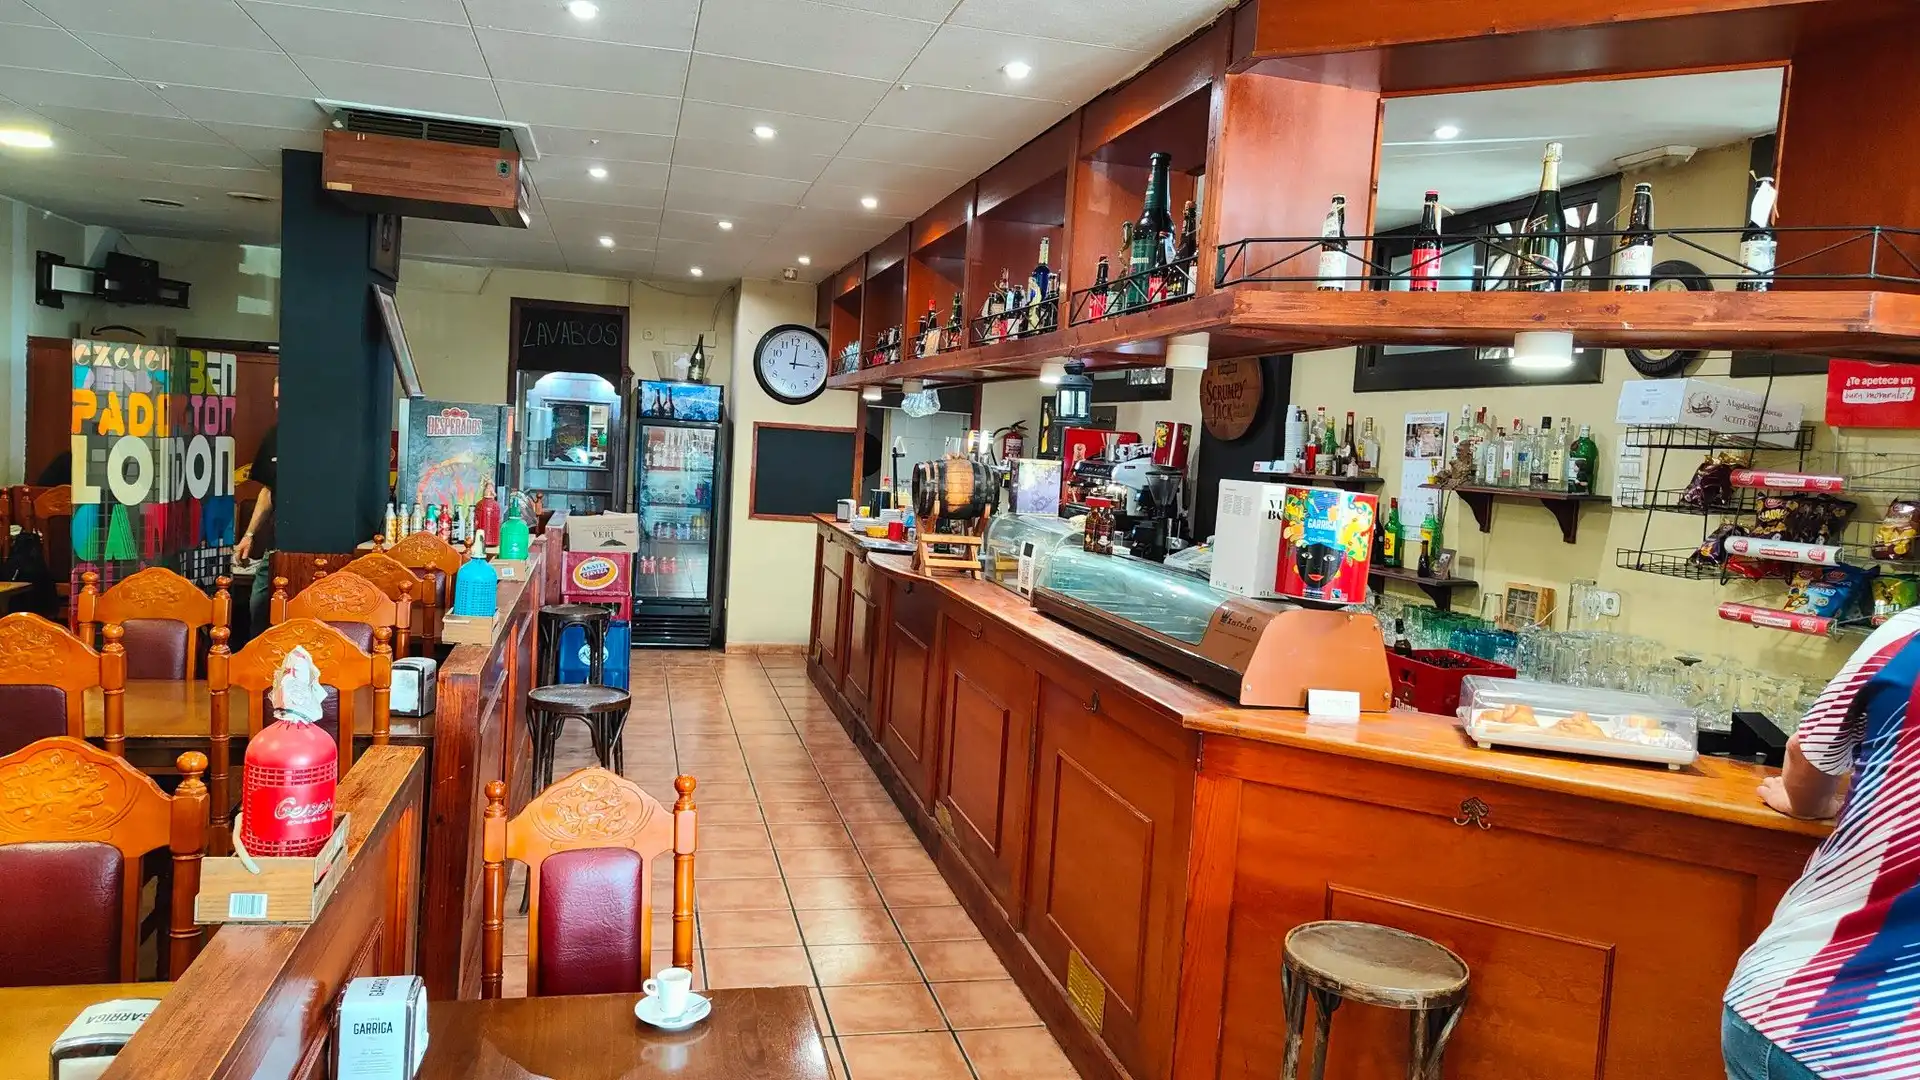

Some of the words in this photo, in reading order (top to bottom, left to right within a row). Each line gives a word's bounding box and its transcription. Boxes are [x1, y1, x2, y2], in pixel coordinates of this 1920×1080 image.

[523, 321, 619, 347] LAVABOS
[1862, 376, 1899, 387] apetece
[1901, 377, 1914, 385] un
[428, 416, 482, 435] DESPERADOS
[353, 1021, 393, 1035] GARRIGA
